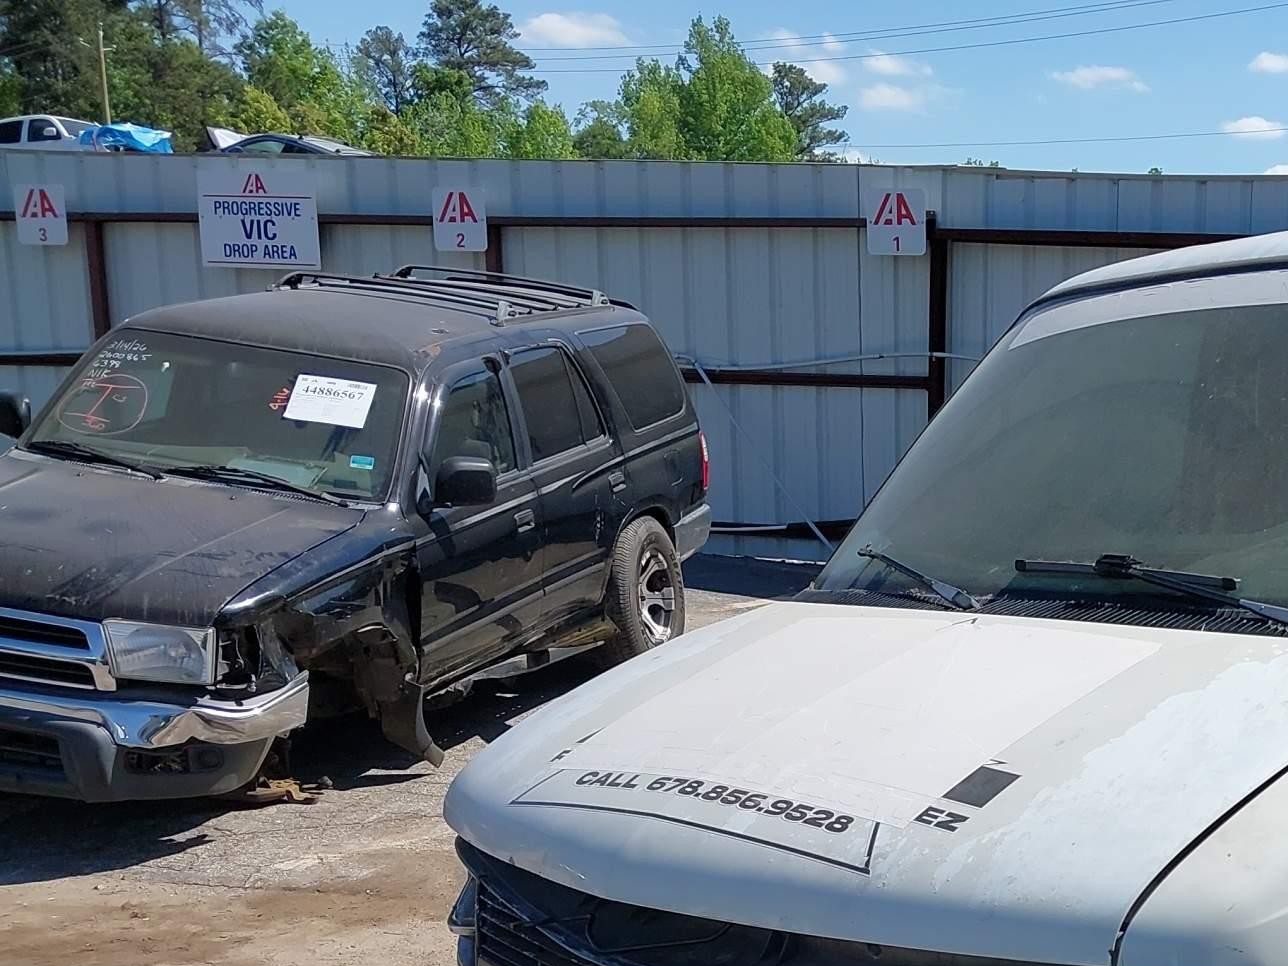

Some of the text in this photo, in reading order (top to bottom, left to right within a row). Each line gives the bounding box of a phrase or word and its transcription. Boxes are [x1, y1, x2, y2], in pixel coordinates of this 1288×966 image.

[213, 200, 302, 217] PROGRESSIVE
[38, 227, 48, 242] 3
[240, 219, 278, 241] VIC
[456, 232, 466, 248] 2
[892, 236, 900, 252] 1
[223, 243, 298, 260] DROP AREA
[302, 385, 365, 402] 44886567
[575, 771, 855, 833] CALL 678.856.9528
[912, 805, 971, 833] EZ
